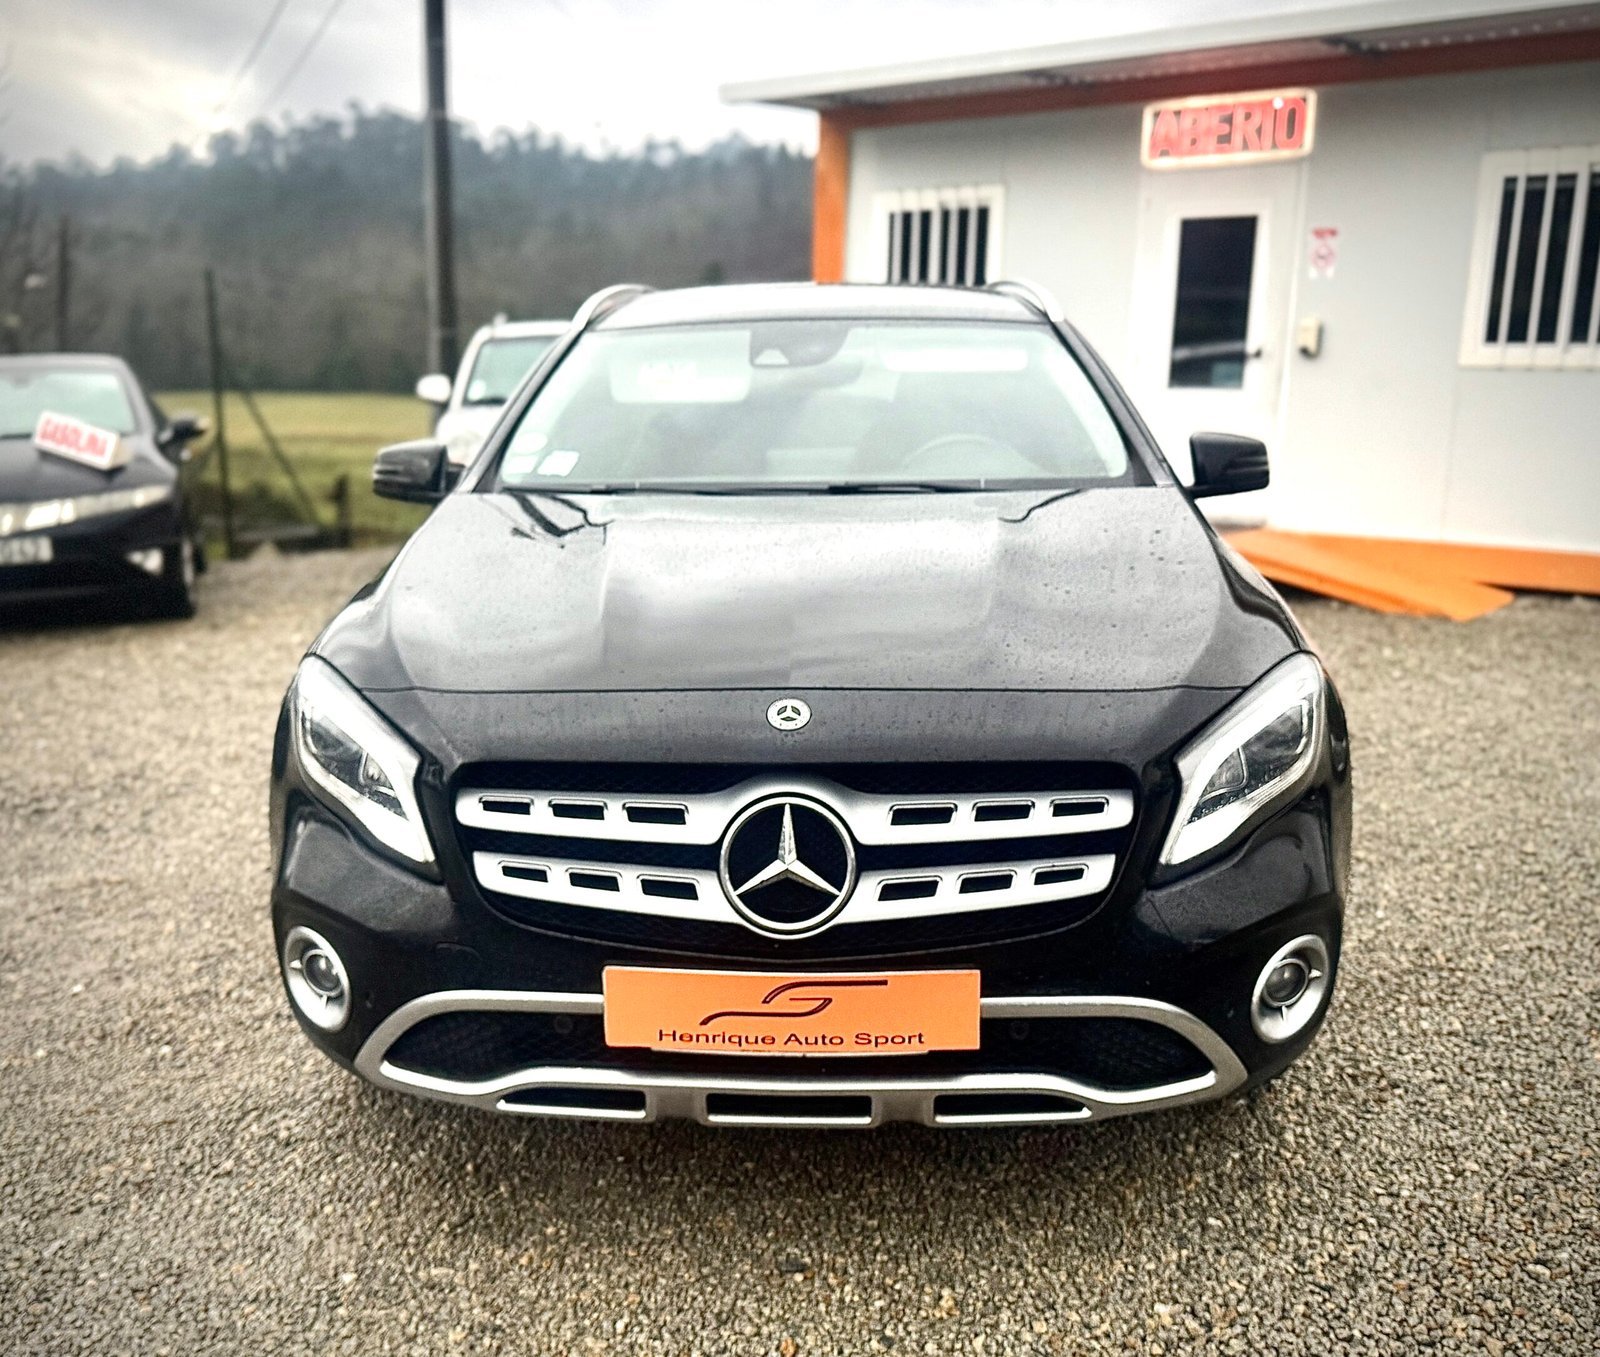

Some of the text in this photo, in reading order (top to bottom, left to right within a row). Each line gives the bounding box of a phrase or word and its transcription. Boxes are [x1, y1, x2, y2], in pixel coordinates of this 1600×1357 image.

[658, 1029, 925, 1048] Henrique Auto Sport
